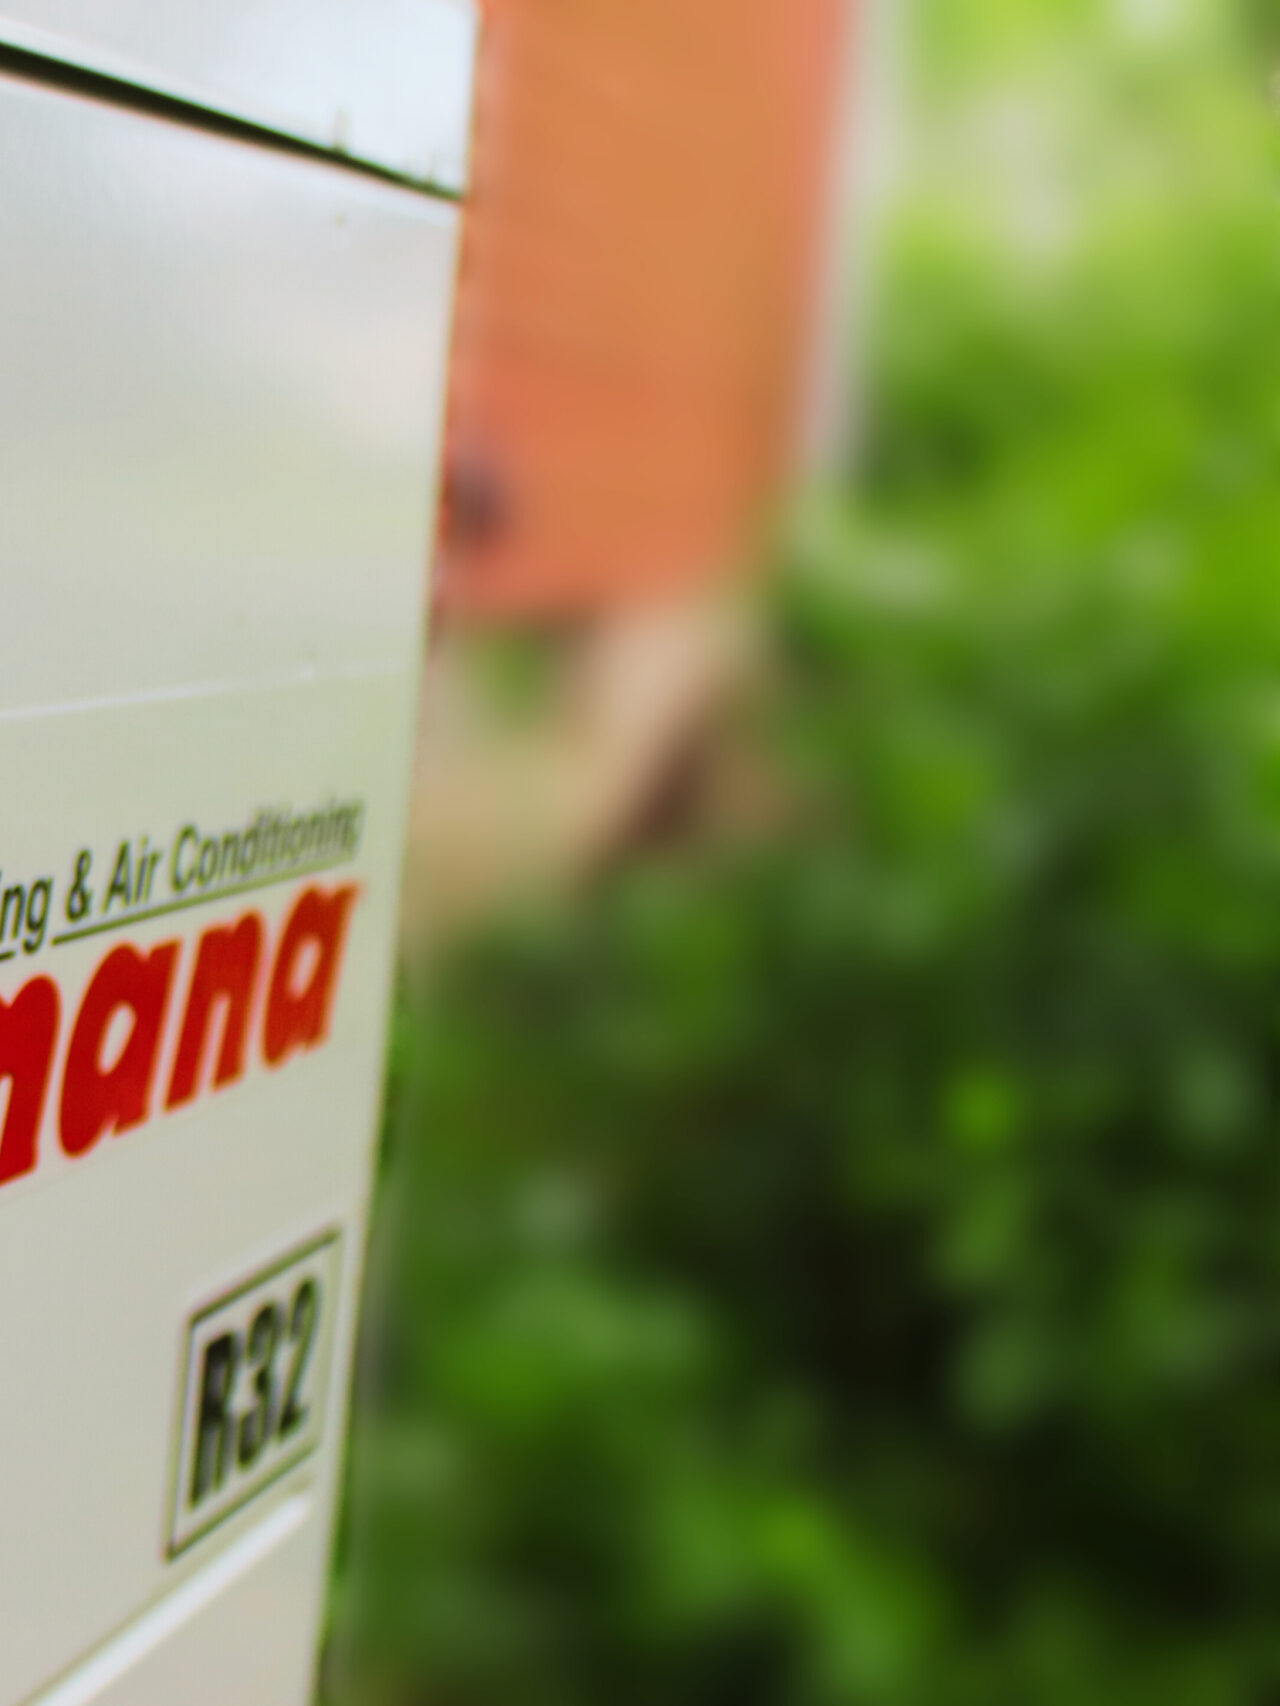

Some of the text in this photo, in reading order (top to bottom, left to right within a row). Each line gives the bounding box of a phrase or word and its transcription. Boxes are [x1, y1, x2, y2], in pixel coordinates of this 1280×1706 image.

[66, 847, 93, 923] &
[102, 835, 161, 914] Air
[188, 1276, 318, 1510] R32
